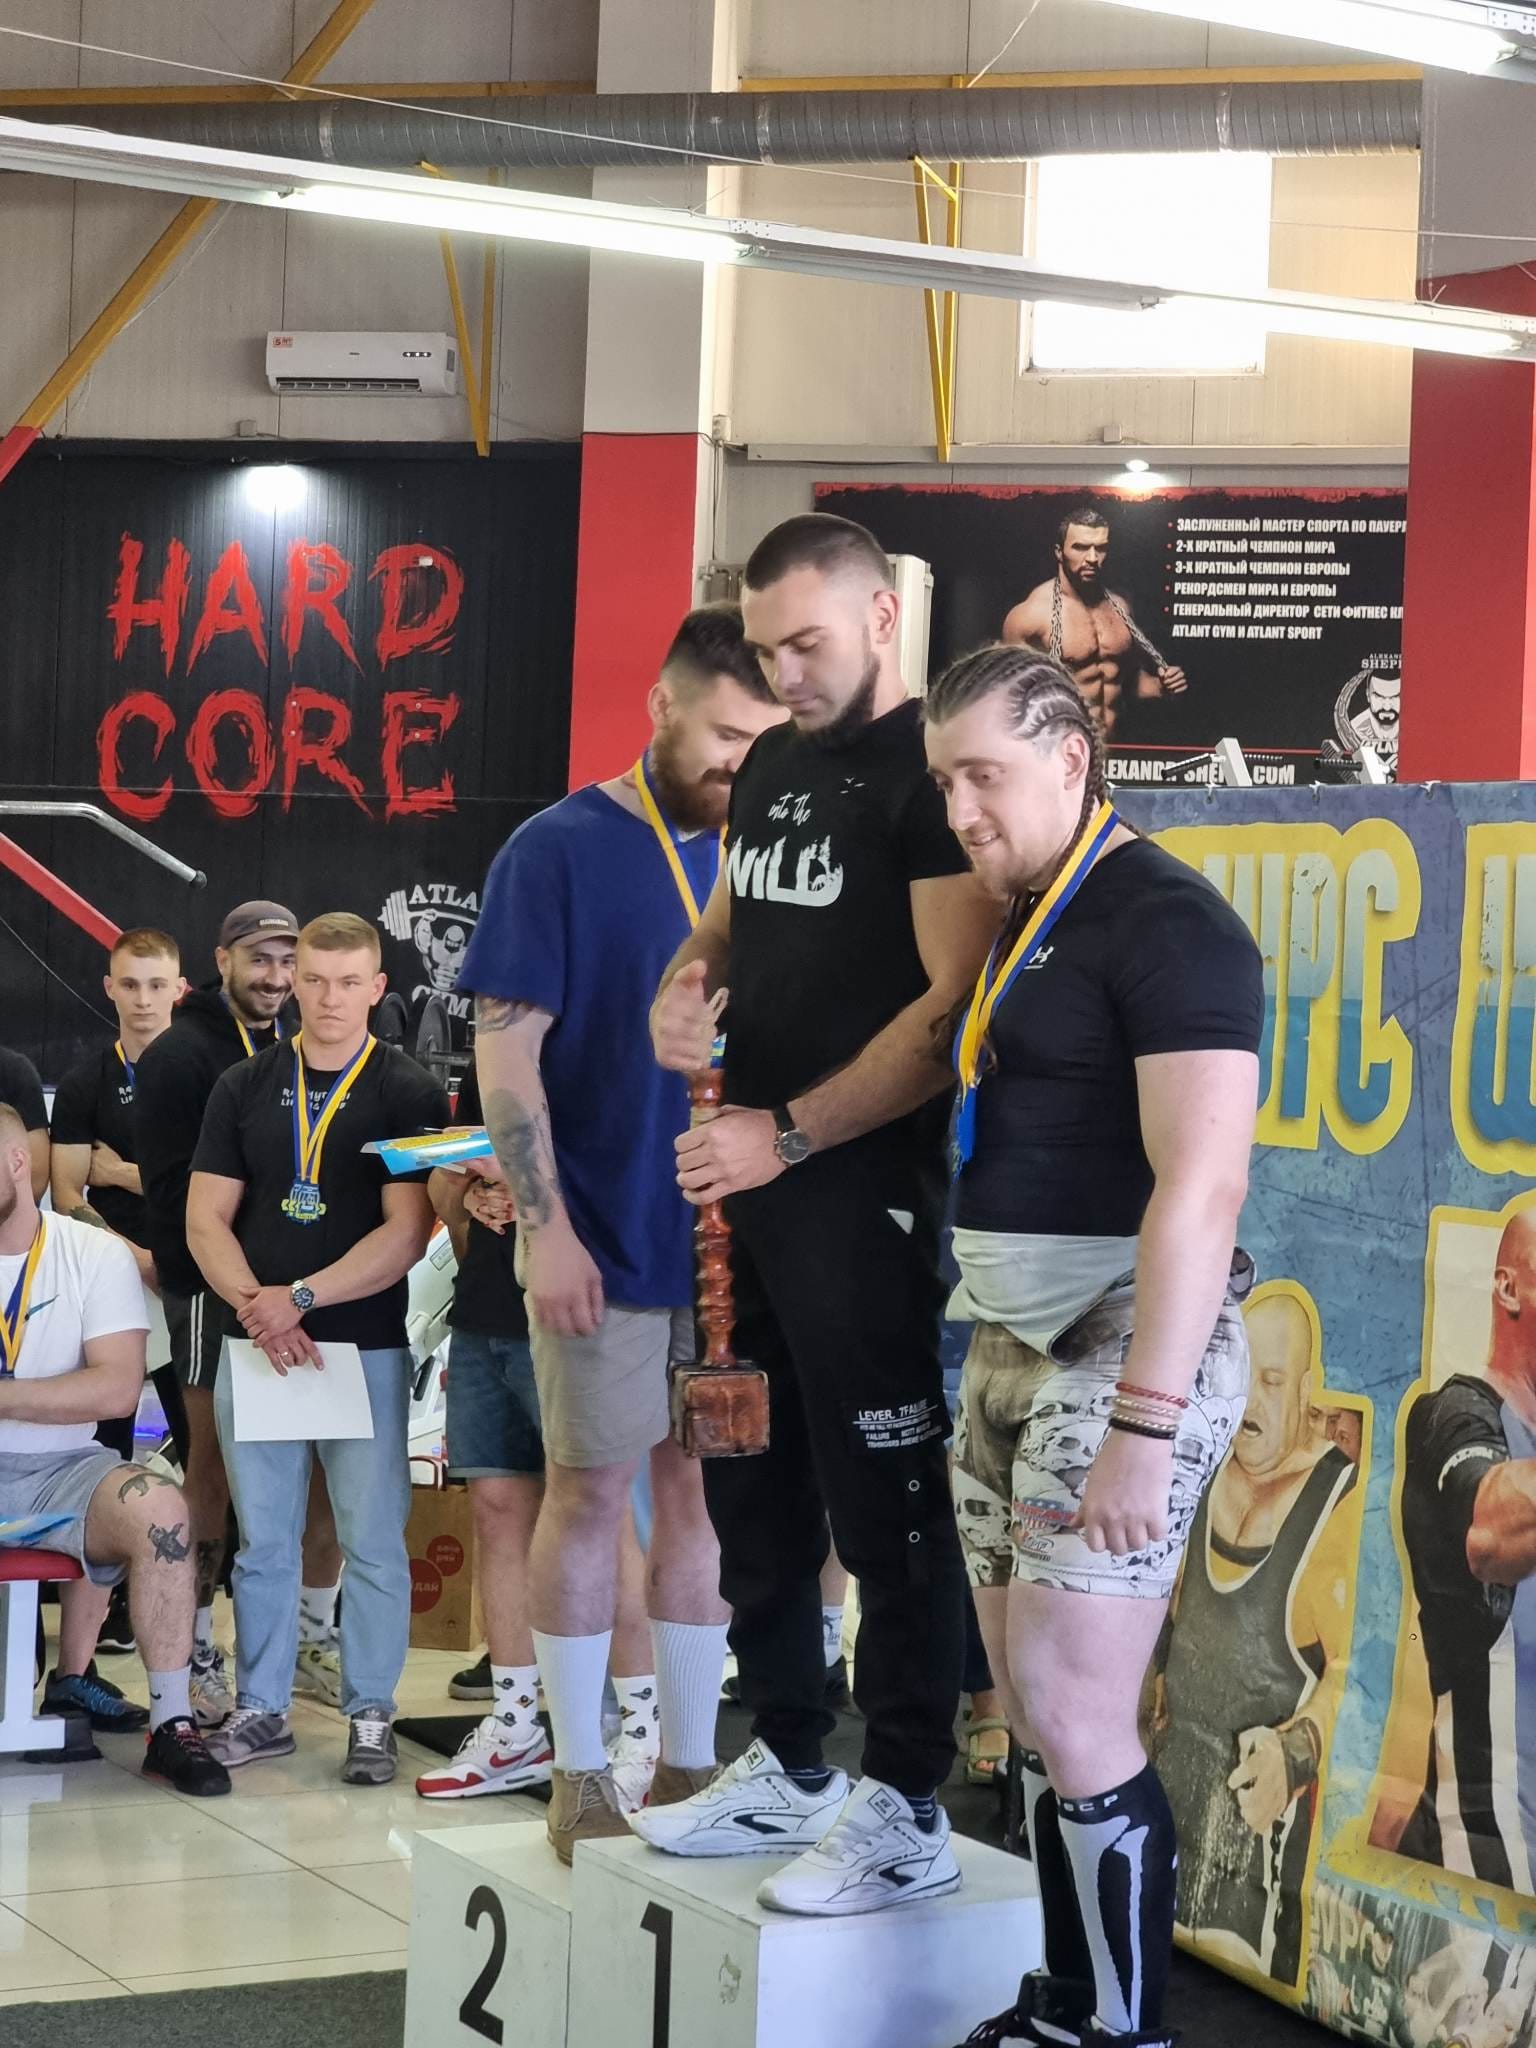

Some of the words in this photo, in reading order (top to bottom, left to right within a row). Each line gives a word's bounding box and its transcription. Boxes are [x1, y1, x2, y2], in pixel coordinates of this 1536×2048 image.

[1177, 518, 1260, 532] ЗАСЛУЖЕННЫЙ
[1263, 520, 1305, 532] МАСТЕР
[1307, 520, 1349, 533] СПОРТА
[1351, 520, 1367, 533] ПО
[1196, 539, 1248, 553] КРАТНЫЙ
[1250, 541, 1302, 553] ЧЕМПИОН
[1304, 541, 1335, 554] МИРА
[1195, 560, 1247, 574] КРАТНЫЙ
[1249, 562, 1302, 575] ЧЕМПИОН
[1304, 562, 1350, 575] ЕВРОПЫ
[1174, 583, 1246, 597] РЕКОРДСМЕН
[1248, 583, 1279, 596] МИРА
[1281, 584, 1288, 596] И
[1291, 584, 1336, 597] ЕВРОПЫ
[107, 531, 464, 678] HARD
[1173, 602, 1251, 618] ГЕНЕРАЛЬНЫЙ
[1253, 604, 1309, 619] ДИРЕКТОР
[1314, 605, 1340, 618] СЕТИ
[1342, 605, 1387, 619] ФИТНЕС
[1172, 625, 1210, 638] ATLANT
[1212, 626, 1236, 638] GYM
[1247, 626, 1285, 639] ATLANT
[1287, 627, 1322, 640] SPORT
[97, 682, 461, 822] CORE
[409, 884, 481, 912] ATLA
[459, 1885, 507, 2046] 2
[640, 1900, 673, 2048] 1
